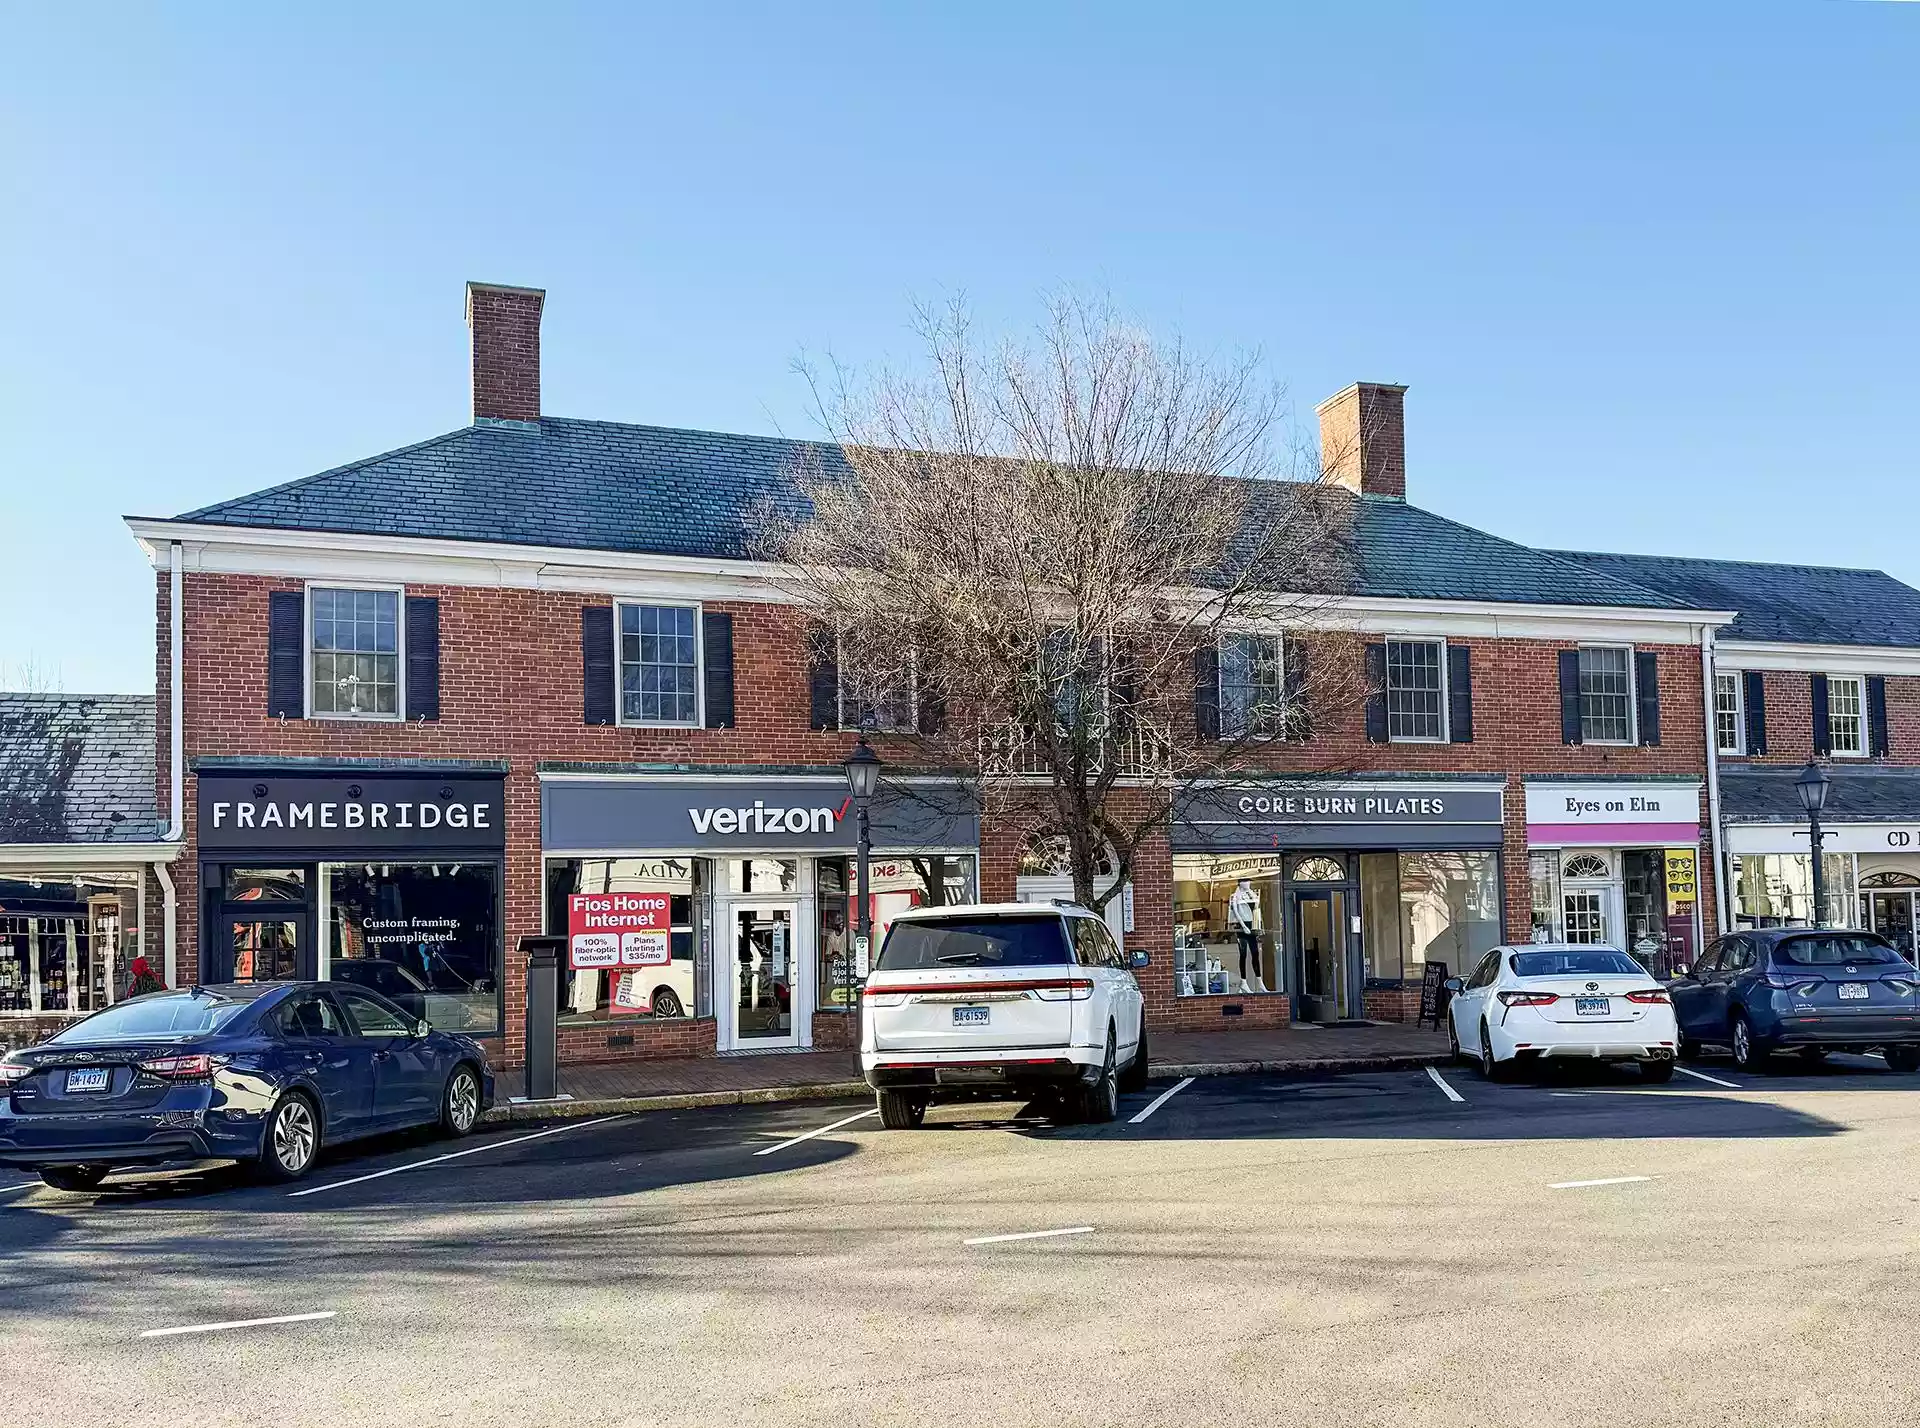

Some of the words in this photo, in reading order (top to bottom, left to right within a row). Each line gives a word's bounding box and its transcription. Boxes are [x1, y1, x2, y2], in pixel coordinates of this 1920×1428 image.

[1238, 797, 1296, 813] CORE
[1304, 798, 1357, 814] BURN
[1365, 798, 1444, 814] PILATES
[1565, 797, 1600, 816] Eyes
[1605, 801, 1624, 811] on
[1629, 797, 1660, 811] Elm
[212, 802, 490, 828] FRAMEBRIDGE
[688, 800, 834, 834] verizon
[1887, 831, 1911, 847] CD
[573, 897, 611, 912] Fios
[614, 896, 666, 911] Home
[363, 917, 408, 928] Custom
[411, 916, 460, 928] framing,
[585, 912, 655, 927] Internet
[367, 930, 457, 944] uncomplicated.
[634, 937, 656, 945] Plans
[575, 946, 616, 955] fiber-optic
[625, 945, 655, 953] starting
[579, 954, 612, 962] network
[629, 952, 661, 961] $35/mo
